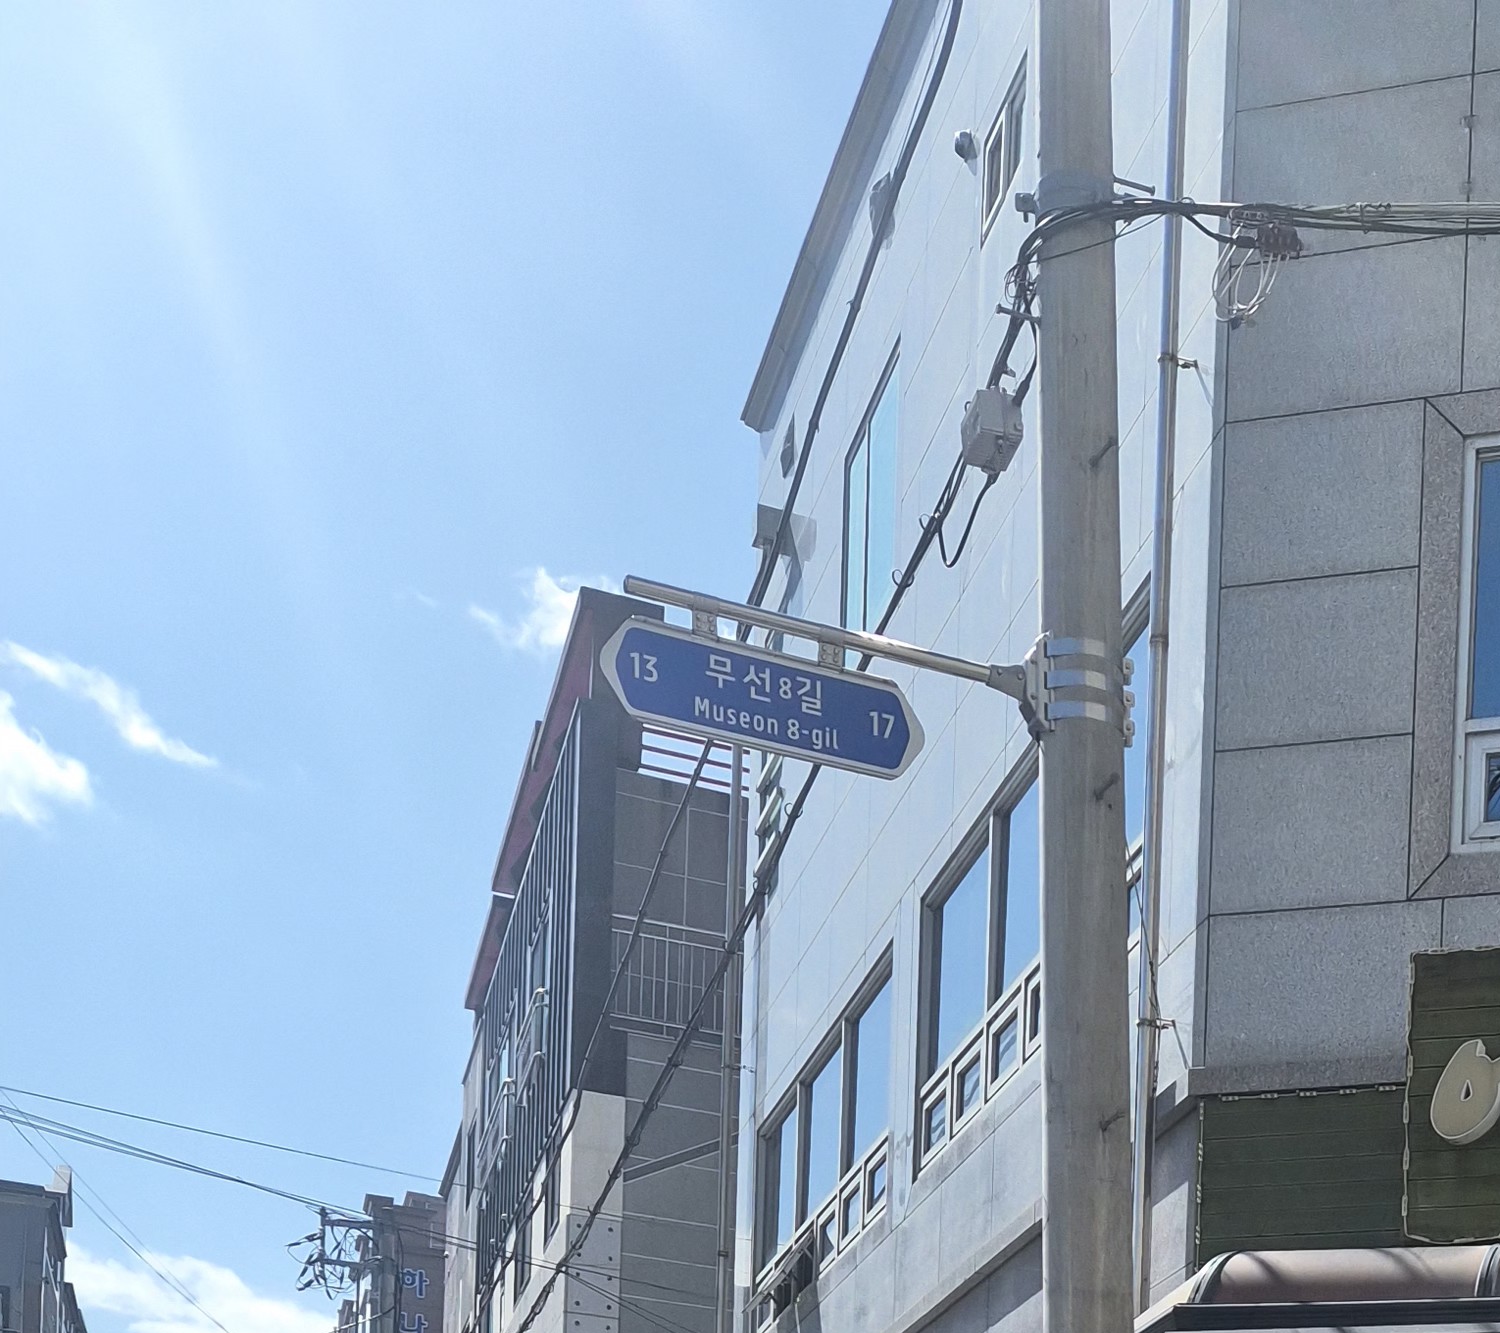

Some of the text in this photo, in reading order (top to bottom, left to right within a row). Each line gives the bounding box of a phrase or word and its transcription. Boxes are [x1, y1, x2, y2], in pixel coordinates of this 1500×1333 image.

[629, 652, 658, 682] 13
[705, 653, 822, 716] 무선8길
[694, 696, 838, 750] Museon 8-gil
[869, 711, 895, 739] 17
